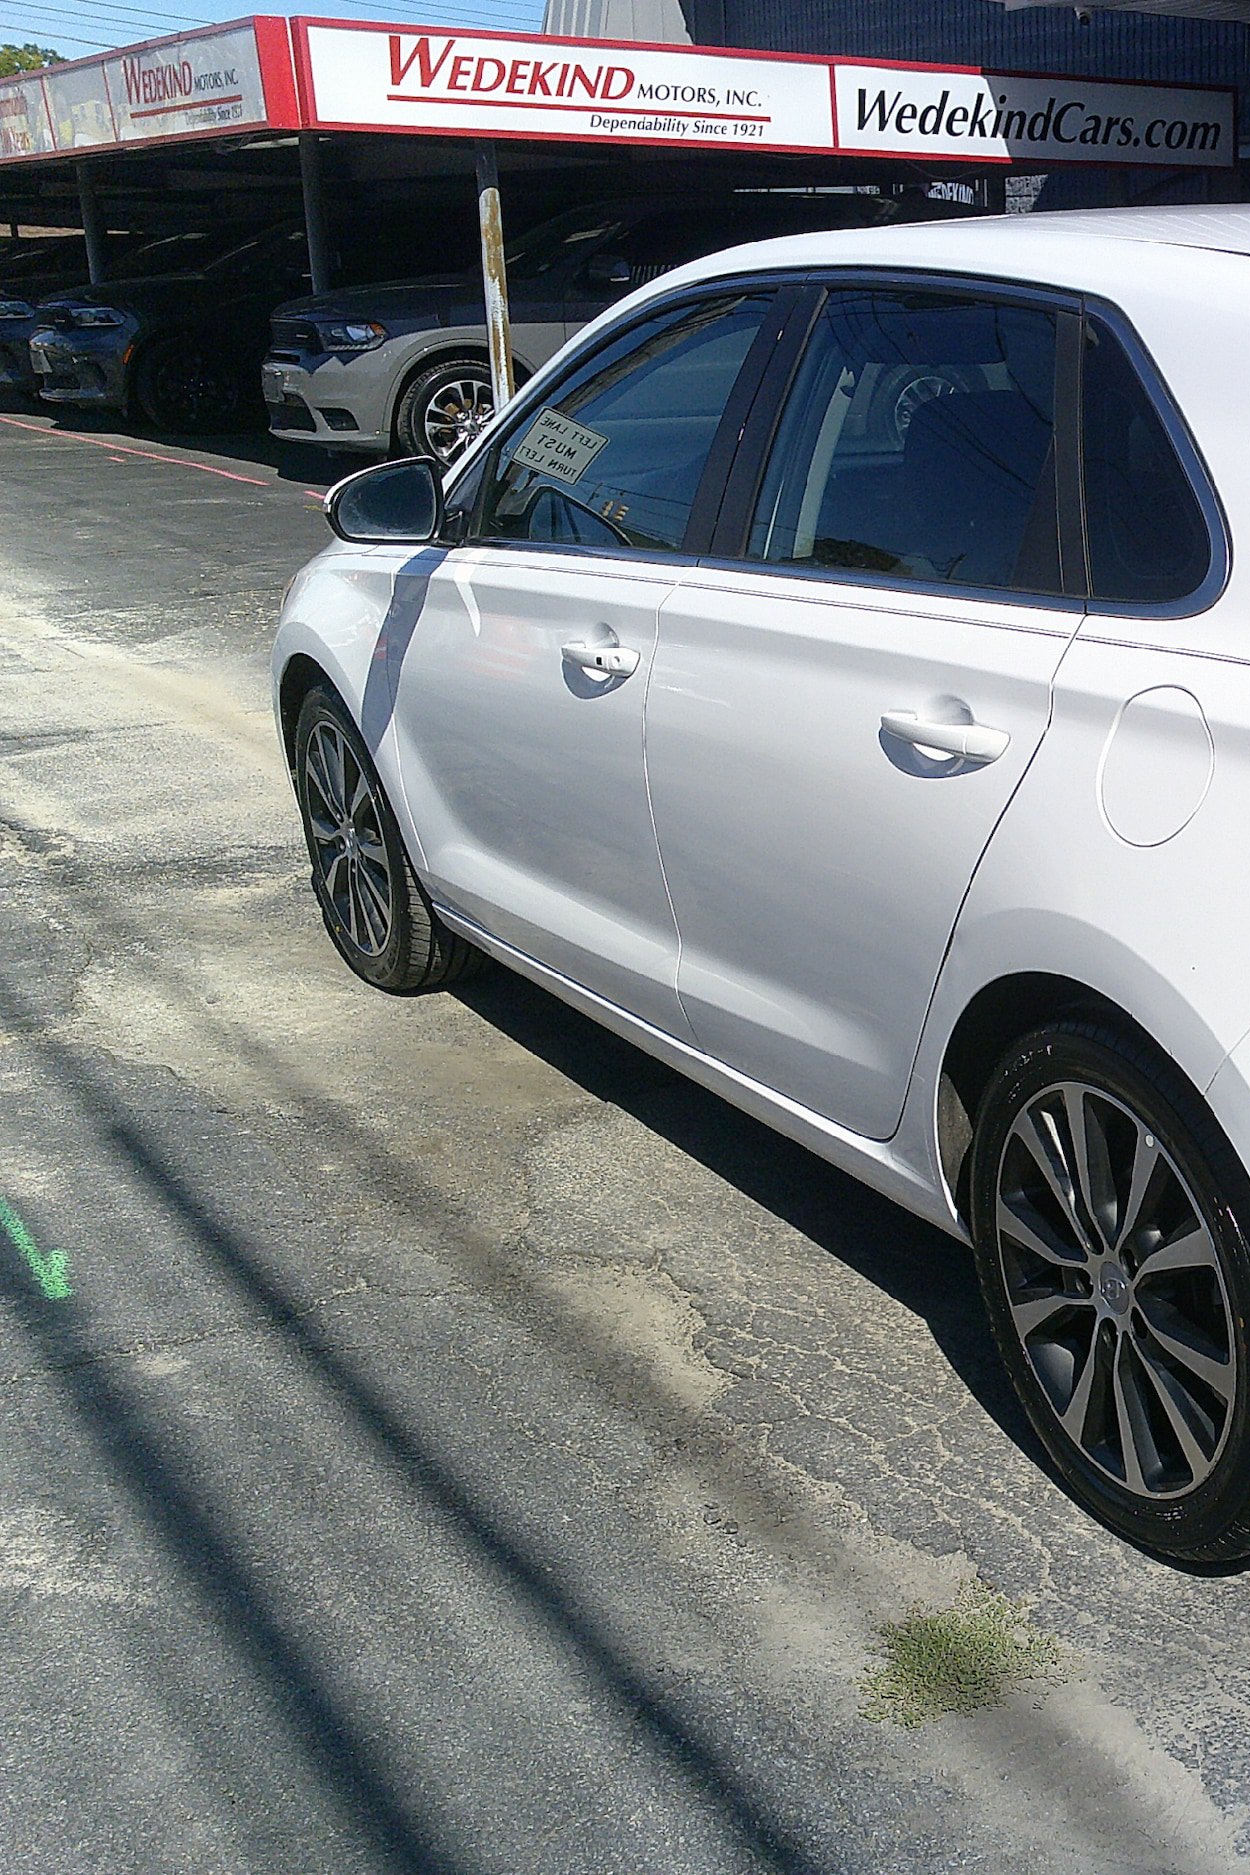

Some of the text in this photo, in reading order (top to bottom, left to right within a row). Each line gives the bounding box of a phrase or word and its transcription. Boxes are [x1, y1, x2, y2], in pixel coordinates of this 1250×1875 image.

[121, 58, 192, 105] WEDEKIND
[389, 35, 762, 108] WEDEKIND MOTORS, INC.
[589, 114, 764, 137] Dependability Since 1921
[856, 87, 1221, 151] WedekindCars.com
